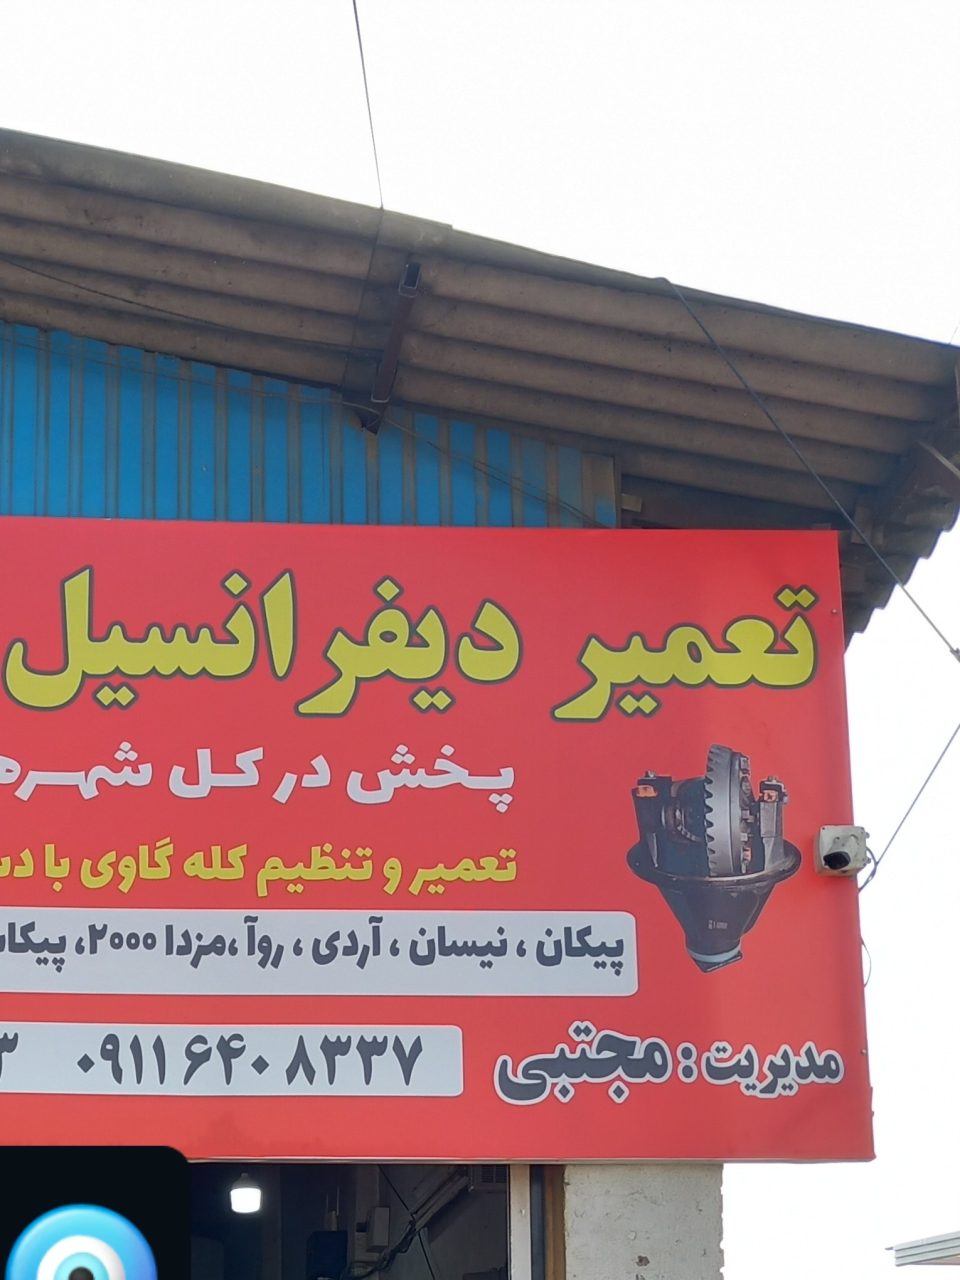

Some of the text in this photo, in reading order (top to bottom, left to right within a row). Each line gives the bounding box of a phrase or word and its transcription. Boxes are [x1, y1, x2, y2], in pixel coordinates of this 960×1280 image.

[551, 584, 818, 722] تعمیر
[168, 747, 263, 799] کل
[273, 754, 332, 804] در
[346, 744, 515, 813] پخش
[44, 843, 71, 893] با
[81, 836, 174, 894] گاوی
[183, 844, 247, 880] کله
[257, 842, 374, 897] تنظیم
[383, 856, 403, 895] و
[409, 847, 518, 896] تعمیر
[409, 926, 509, 967] نیسان
[285, 1034, 423, 1087] ۸۳۳۷
[495, 1022, 672, 1104] مجتبی
